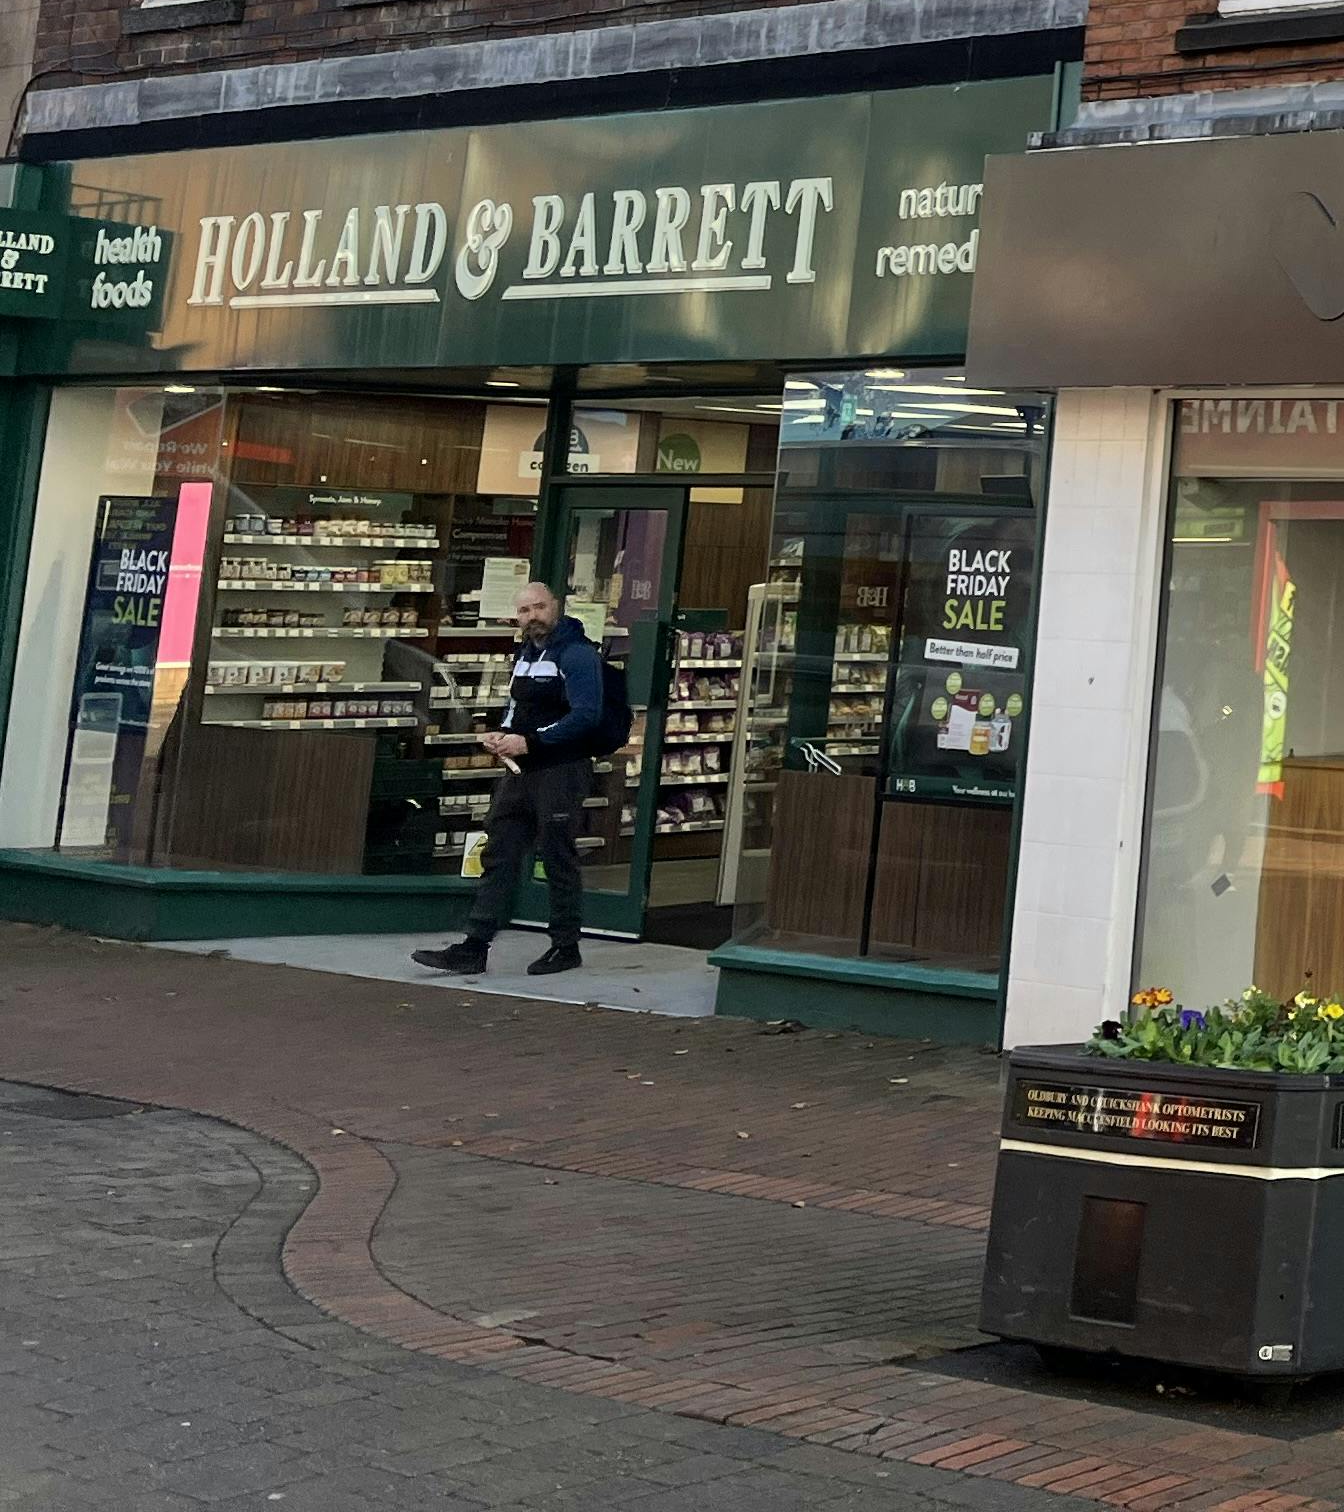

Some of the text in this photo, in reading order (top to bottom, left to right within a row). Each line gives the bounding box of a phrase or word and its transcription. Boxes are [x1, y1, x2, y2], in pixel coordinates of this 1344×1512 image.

[94, 225, 162, 265] health
[187, 177, 834, 306] HOLLAND & BARRETT
[0, 249, 20, 270] &
[0, 270, 48, 294] RETT
[91, 269, 153, 309] foods
[656, 448, 698, 471] New
[120, 549, 168, 573] BLACK
[948, 549, 1012, 573] BLACK
[116, 571, 166, 595] FRIDAY
[946, 574, 1010, 597] FRIDAY
[112, 595, 161, 627] SALE
[943, 598, 1006, 631] SALE
[929, 642, 1013, 664] Better than half price
[1027, 1089, 1067, 1105] OLDBURY
[1071, 1092, 1089, 1107] AND
[1162, 1103, 1246, 1122] OPTOMETRISTS
[1027, 1106, 1066, 1121] KEEPING
[1141, 1117, 1190, 1135] LOOKING
[1191, 1123, 1209, 1136] ITS
[1211, 1125, 1240, 1139] BEST
